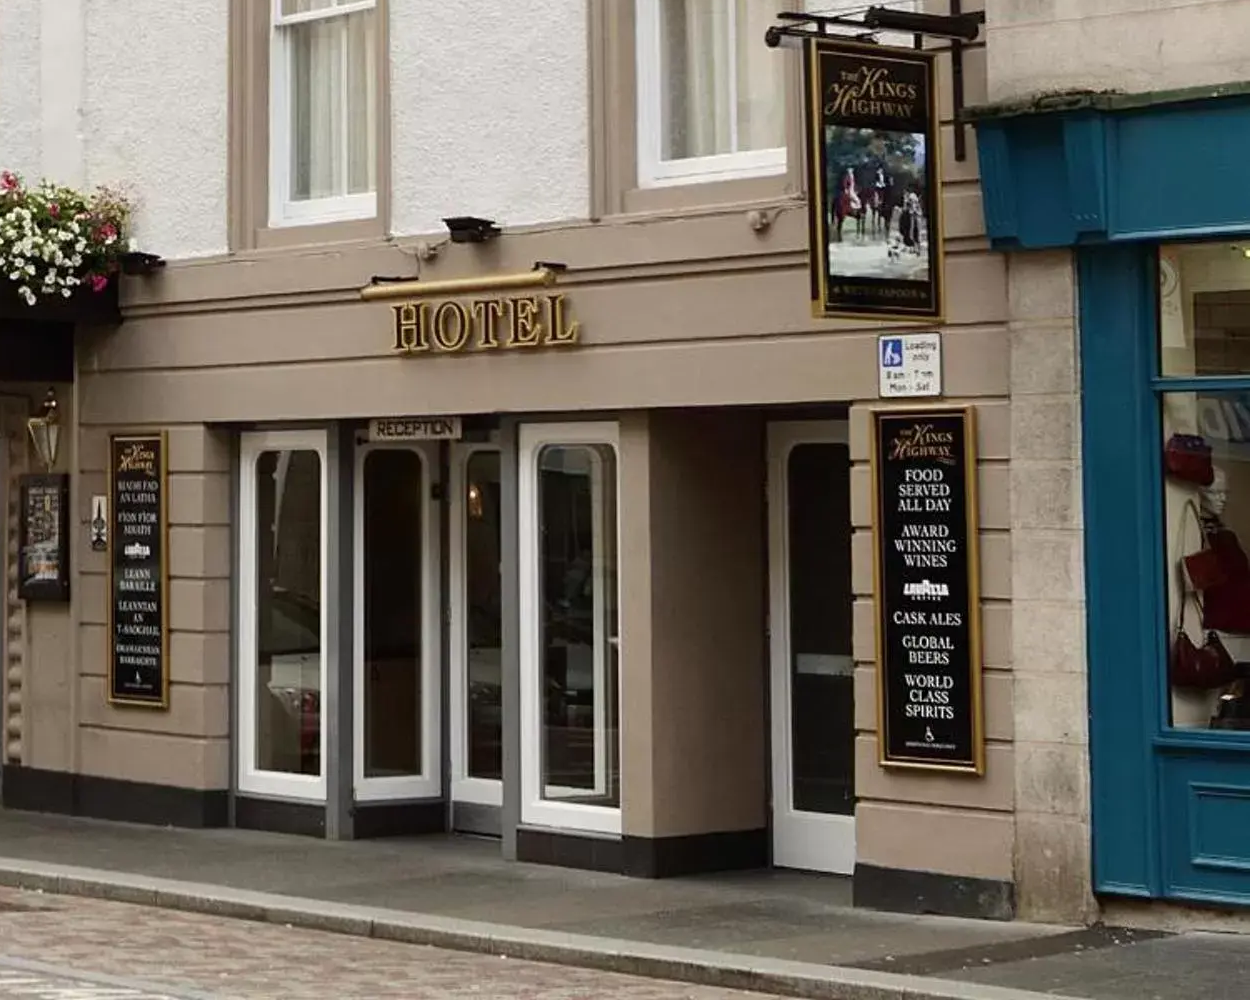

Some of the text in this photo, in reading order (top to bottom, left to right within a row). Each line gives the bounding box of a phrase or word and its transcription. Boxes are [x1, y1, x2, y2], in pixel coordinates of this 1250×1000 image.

[825, 83, 913, 117] HIGHWAY
[391, 292, 580, 351] HOTEL
[905, 341, 937, 351] Loading
[912, 354, 930, 362] only
[889, 383, 907, 392] Mon
[915, 382, 930, 391] Sat
[376, 420, 455, 437] RECEPTION
[905, 468, 944, 482] FOOD
[898, 483, 950, 497] SERVED
[898, 498, 952, 512] ALL DAY
[901, 524, 950, 538] AWARD
[894, 539, 957, 553] WINNING
[903, 554, 948, 568] WINES
[893, 611, 962, 626] CASK ALES
[902, 635, 955, 650] GLOBAL
[908, 651, 950, 665] BEERS
[905, 674, 954, 689] WORLD
[909, 689, 950, 704] CLASS
[905, 704, 955, 719] SPIRITS
